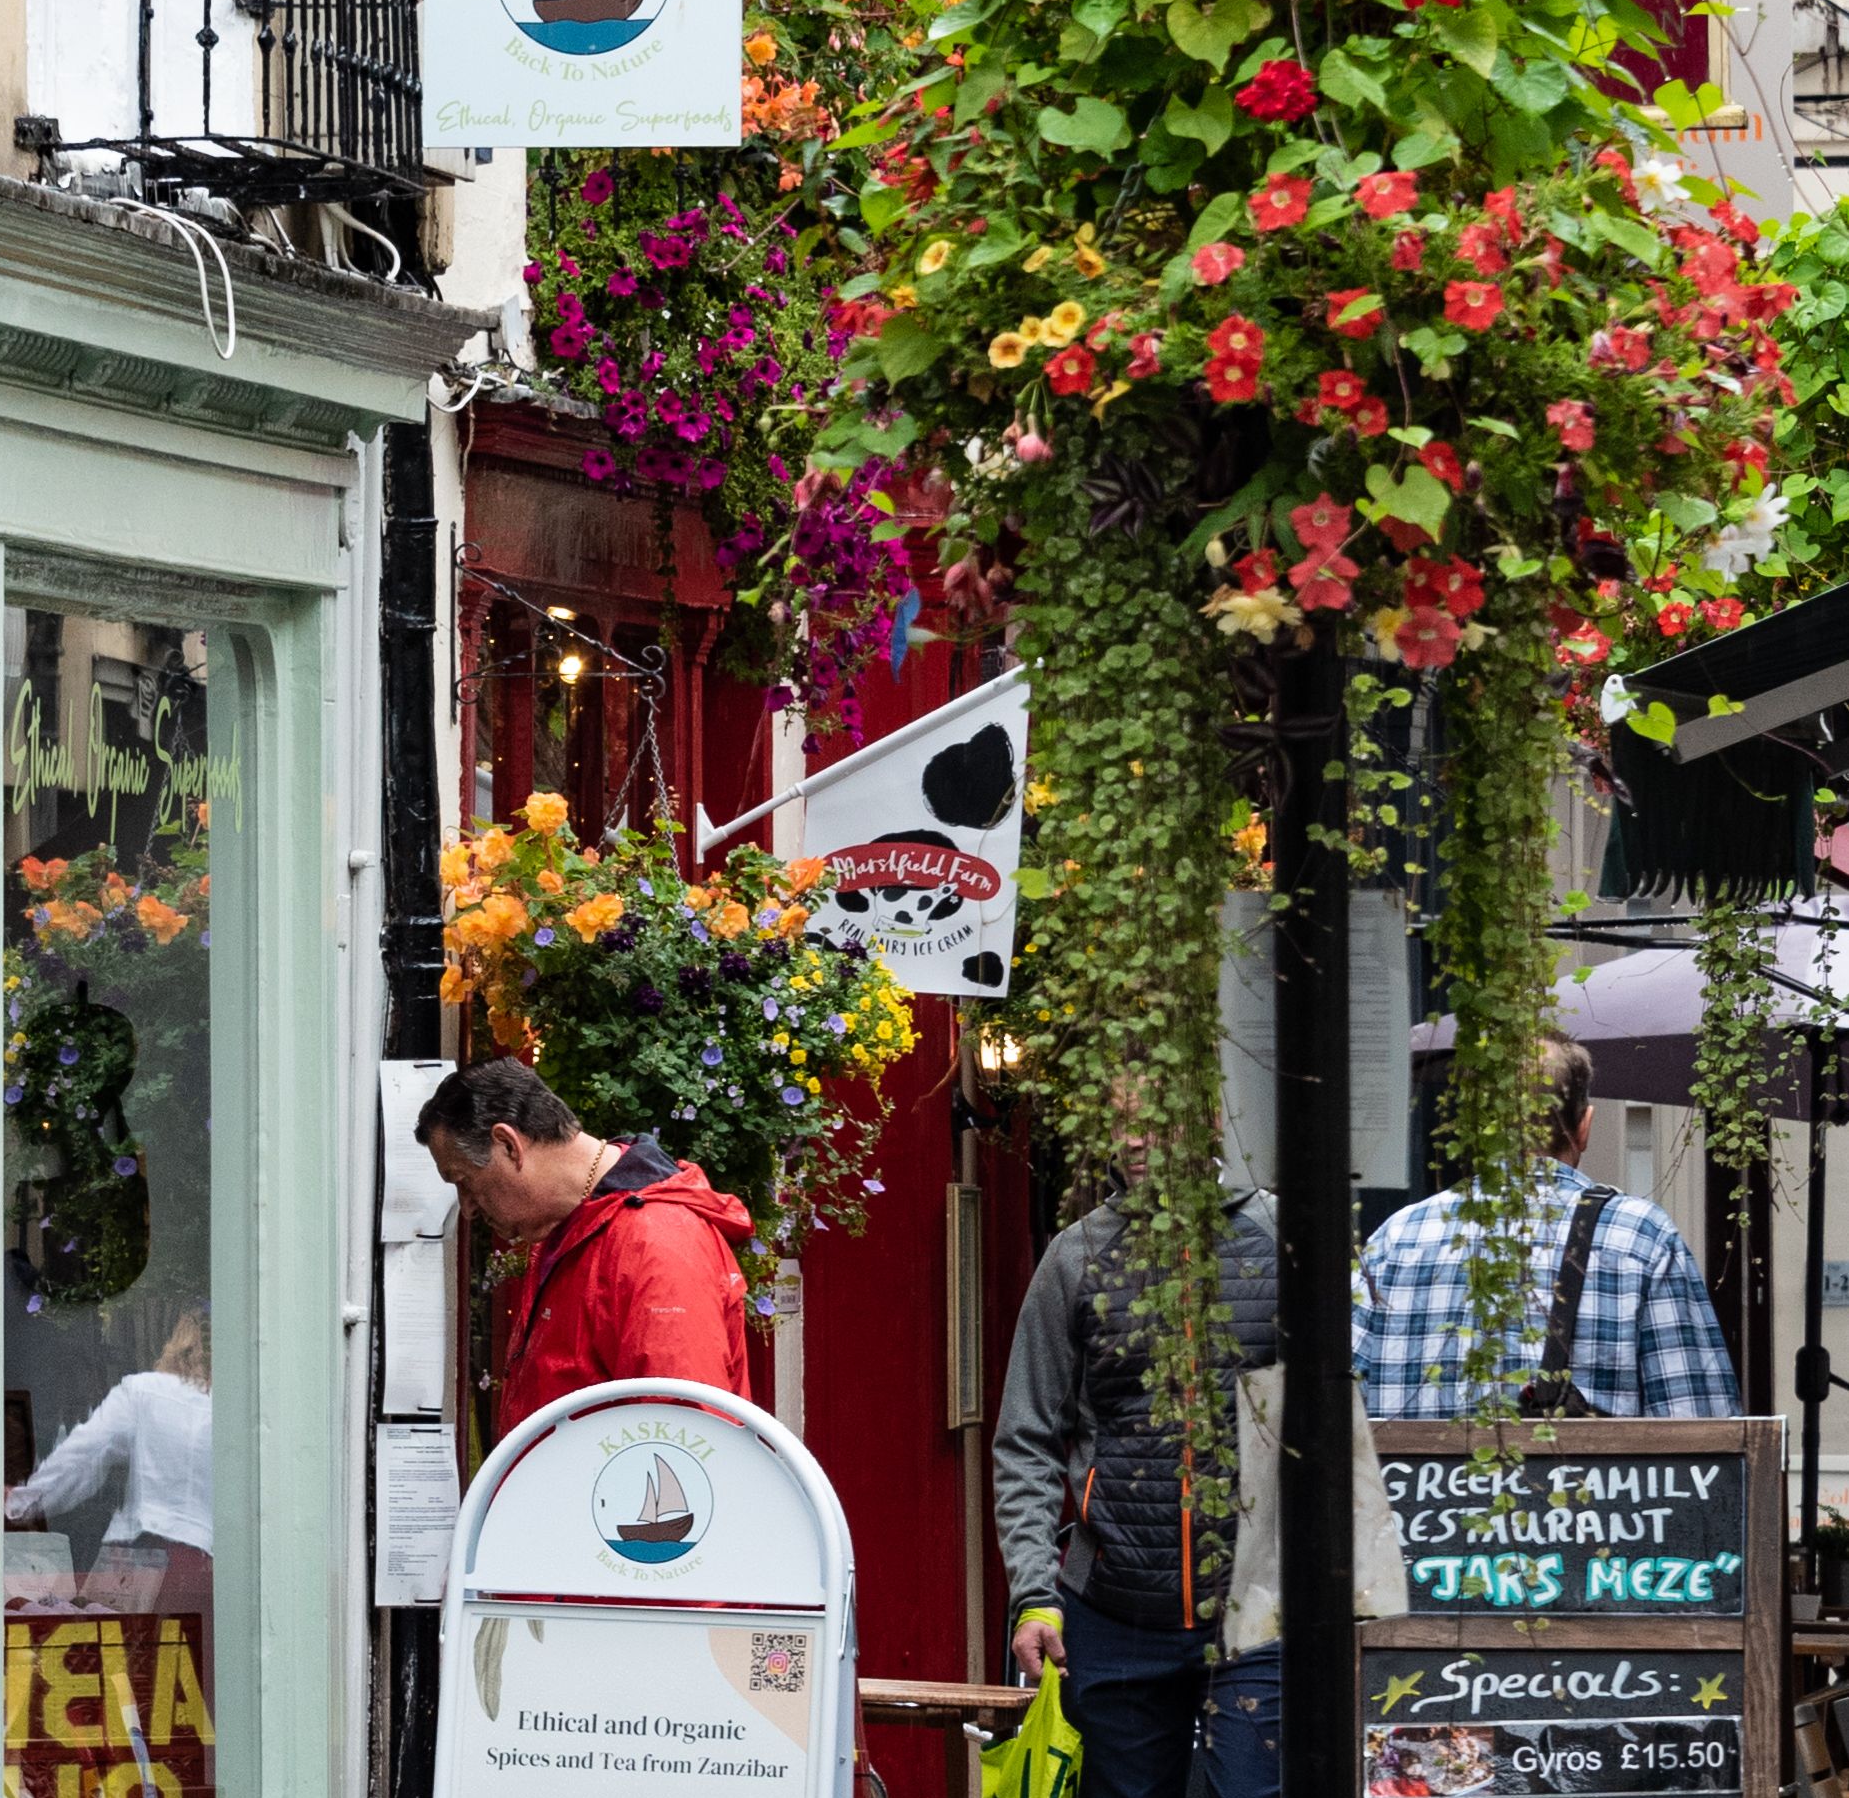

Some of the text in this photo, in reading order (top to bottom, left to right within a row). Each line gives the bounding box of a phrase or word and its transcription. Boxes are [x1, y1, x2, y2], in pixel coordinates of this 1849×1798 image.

[504, 35, 665, 83] Back To Nature
[437, 99, 733, 135] Ethical, Organic Superfoods
[831, 849, 993, 892] Marshfield Farm
[873, 934, 906, 956] AIRY
[913, 940, 933, 957] ICE
[937, 924, 974, 953] CREAM
[597, 1420, 716, 1463] KASKAZI
[1548, 1464, 1721, 1505] FAMILY
[594, 1548, 705, 1582] Back To Nature
[1409, 1659, 1682, 1714] Specials:
[517, 1709, 747, 1744] Ethical and Organic
[486, 1747, 789, 1780] Spices and Tea from Zanzibar
[1512, 1741, 1726, 1779] Gyros £15.50
